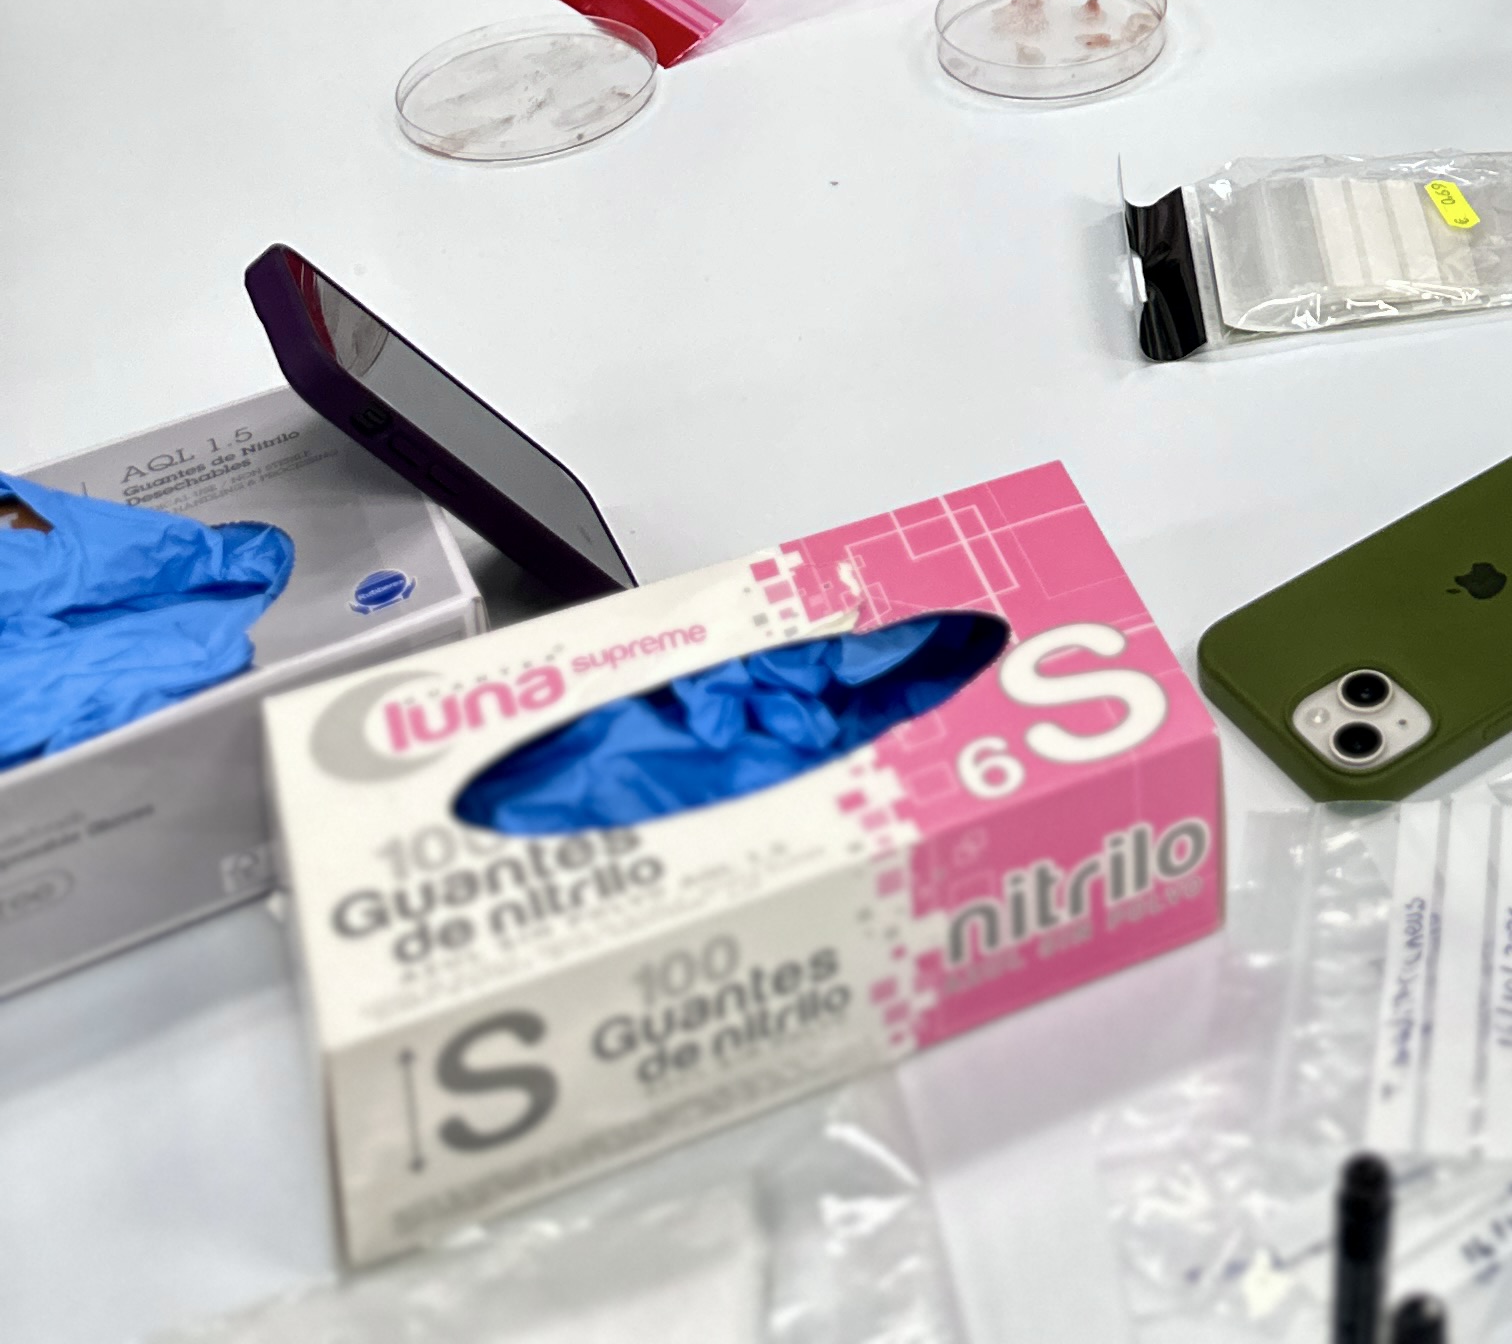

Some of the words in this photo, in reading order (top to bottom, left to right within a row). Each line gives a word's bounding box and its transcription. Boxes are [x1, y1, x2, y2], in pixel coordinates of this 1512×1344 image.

[121, 448, 196, 483] AQL
[207, 426, 253, 454] 1.5
[123, 463, 206, 497] Guantes
[211, 452, 237, 466] de
[241, 430, 300, 457] Nitrilo
[125, 459, 252, 507] Desechables
[383, 665, 567, 753] luna
[570, 623, 708, 674] supreme
[998, 621, 1169, 765] S
[956, 736, 1026, 799] 6
[329, 827, 642, 942] Guantes
[391, 915, 477, 965] de
[488, 856, 666, 936] nitrilo
[946, 817, 1210, 966] nitrilo
[591, 947, 840, 1063] Guantes
[630, 934, 740, 1005] 100
[435, 1009, 559, 1153] S
[635, 1041, 702, 1086] de
[711, 982, 853, 1062] nitrilo
